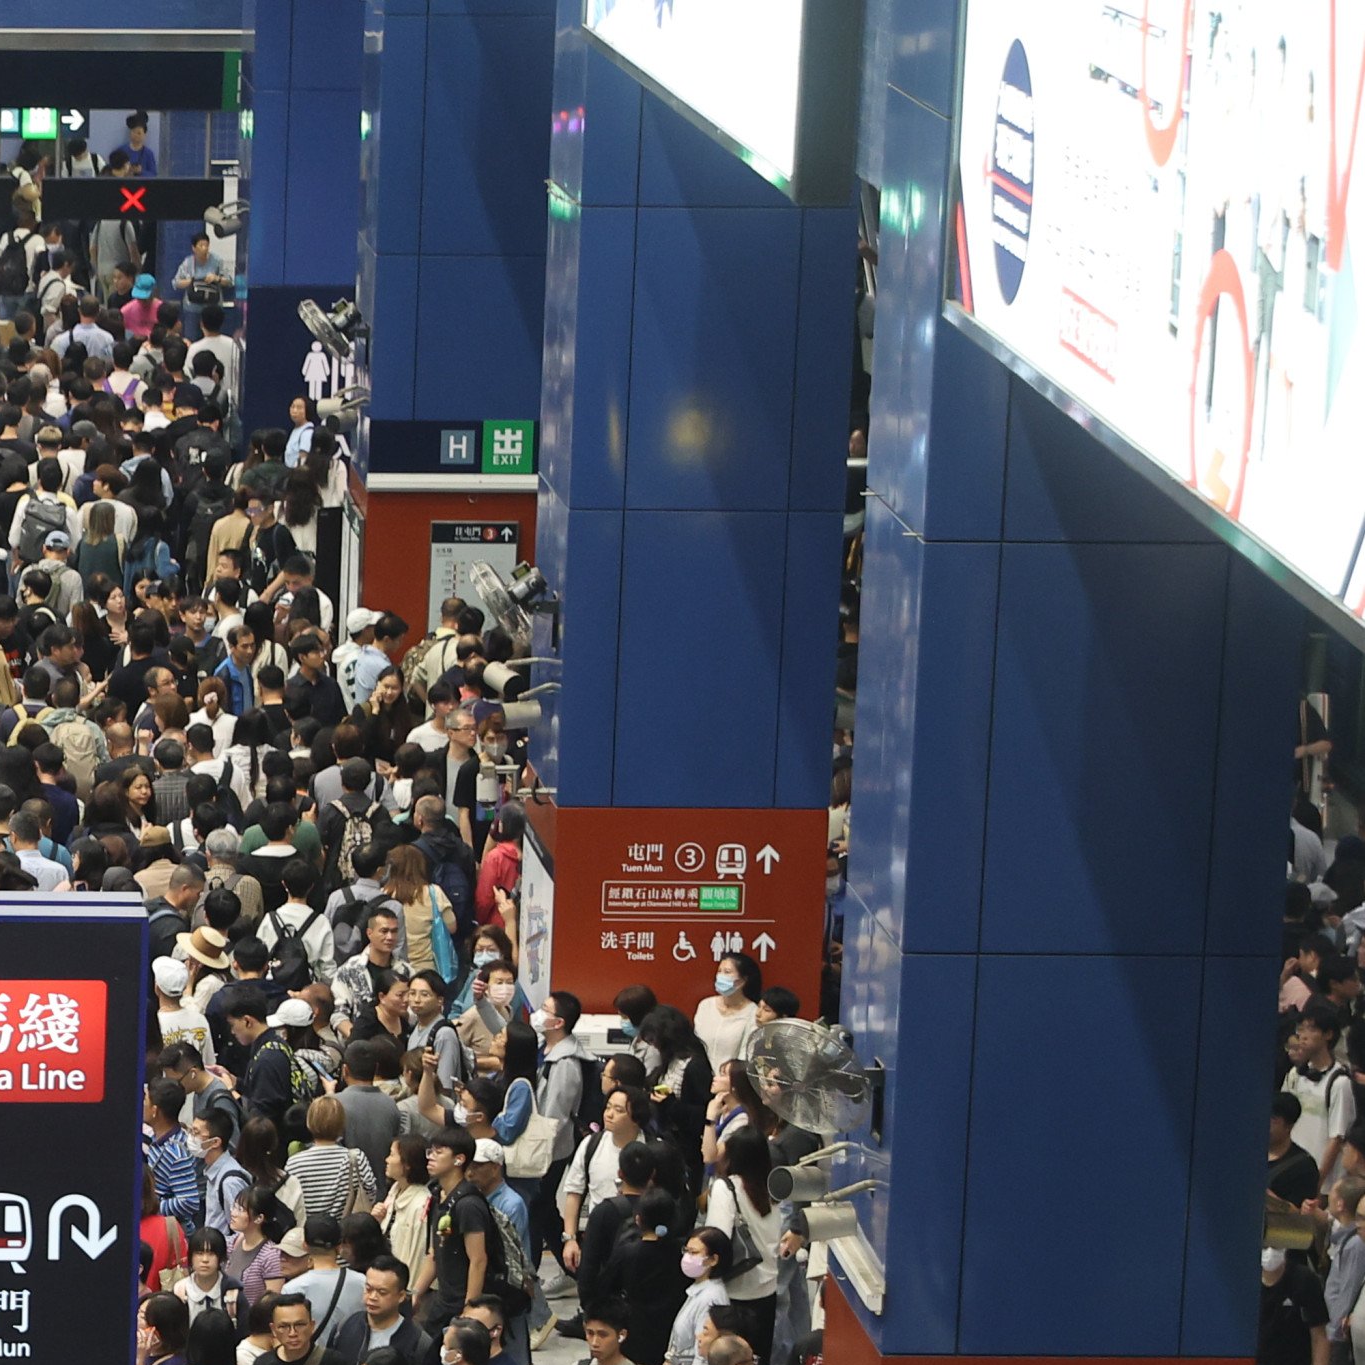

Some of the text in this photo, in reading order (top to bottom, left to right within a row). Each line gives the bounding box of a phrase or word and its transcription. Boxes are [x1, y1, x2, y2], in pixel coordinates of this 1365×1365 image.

[449, 435, 467, 459] H
[493, 455, 521, 465] EXIT
[628, 843, 663, 861] 屯門
[684, 849, 696, 866] 3
[622, 864, 663, 872] Tuen Mun
[601, 932, 654, 949] 洗手間
[627, 952, 654, 960] Toilets
[19, 1063, 85, 1092] Line
